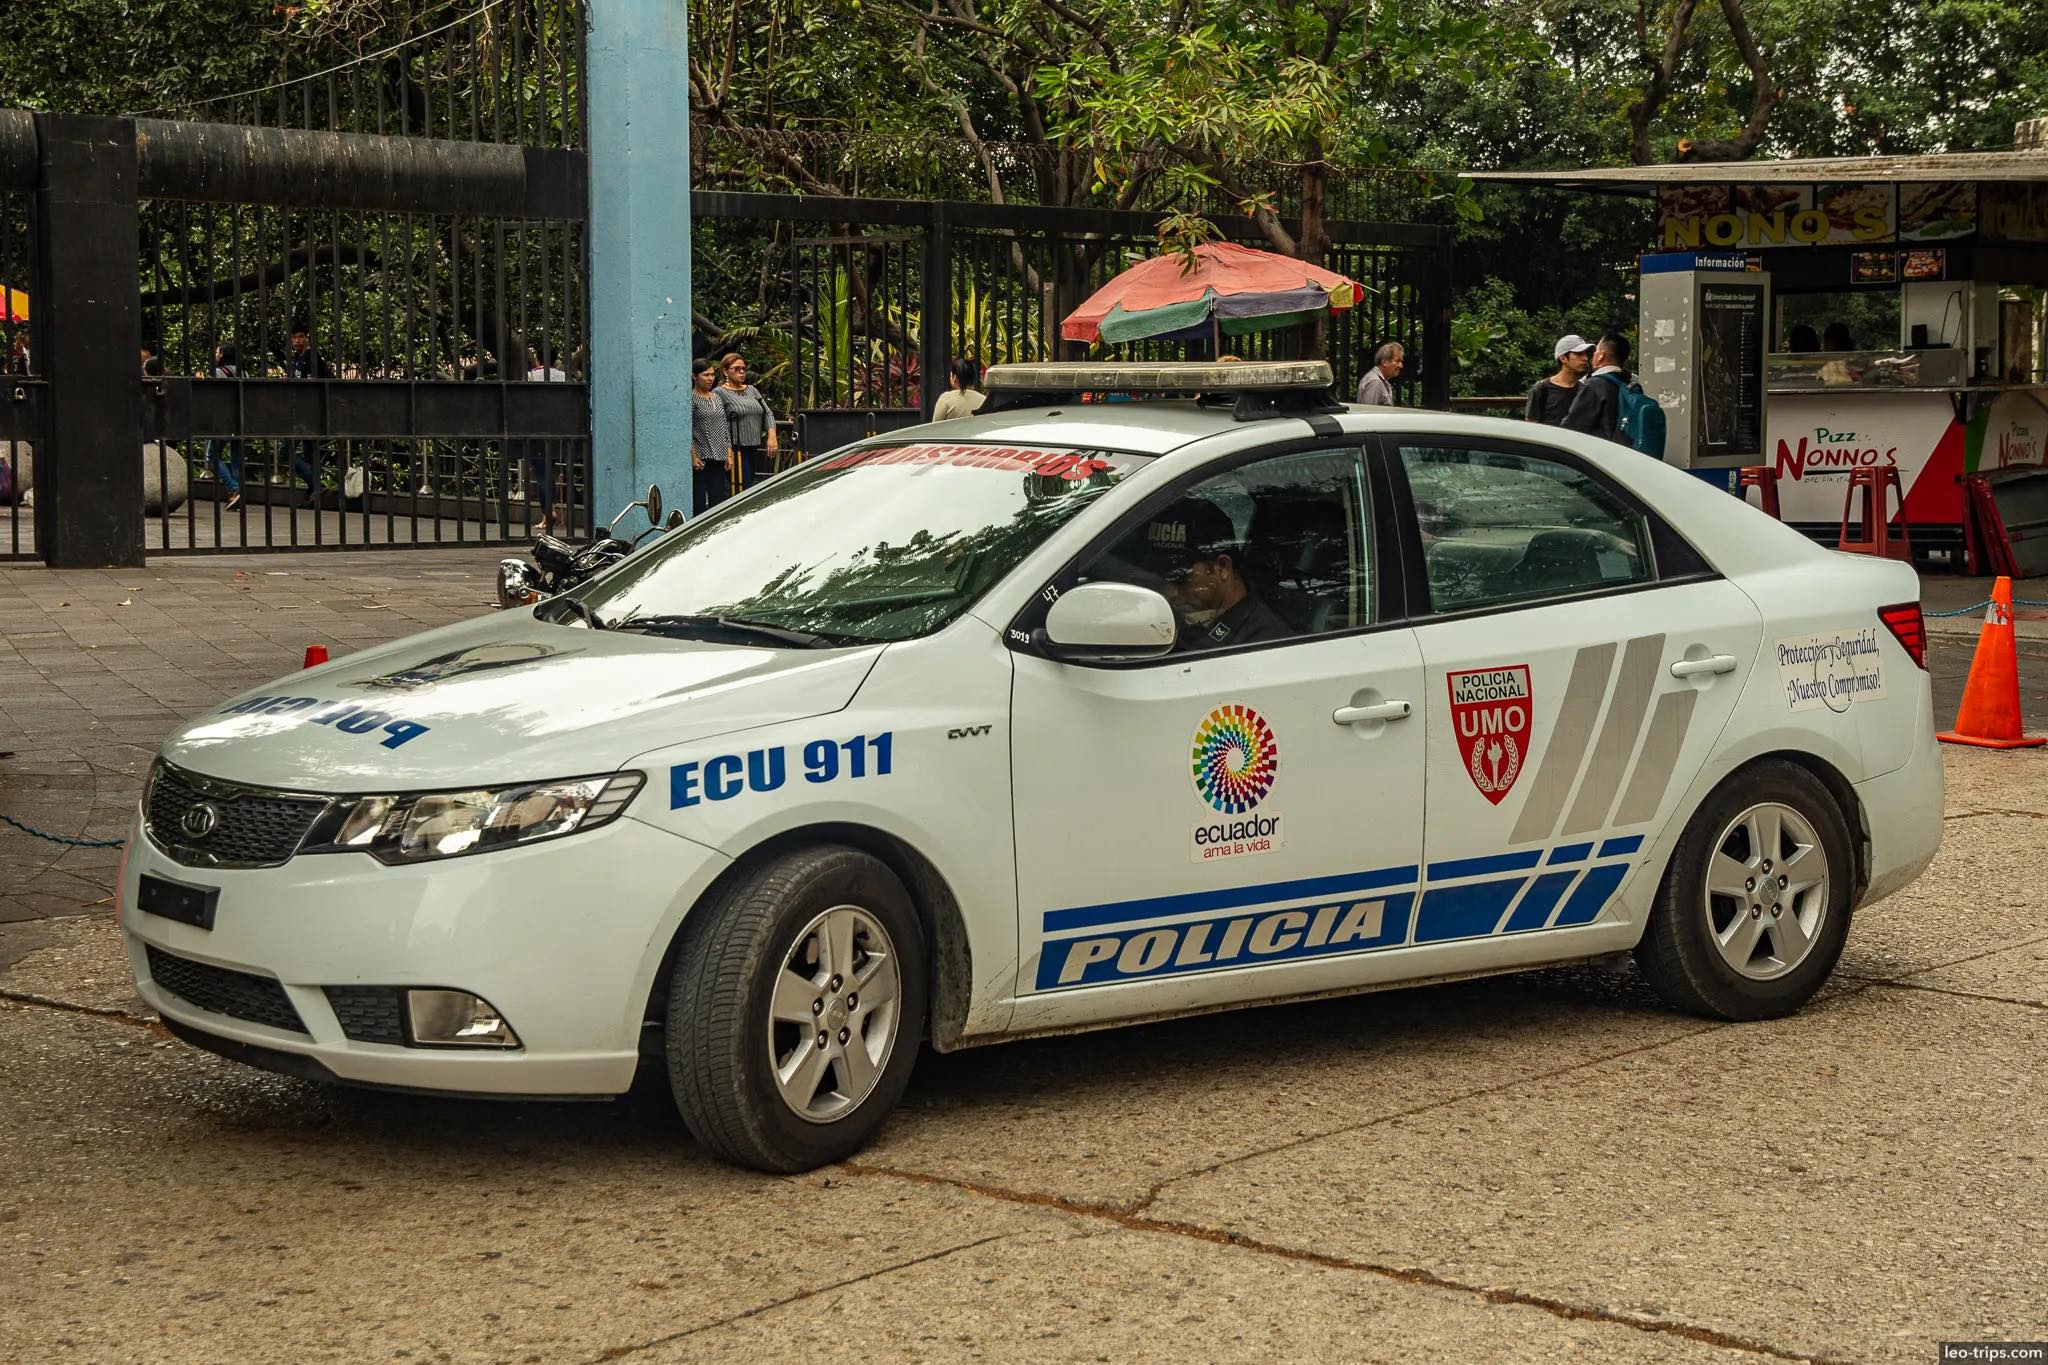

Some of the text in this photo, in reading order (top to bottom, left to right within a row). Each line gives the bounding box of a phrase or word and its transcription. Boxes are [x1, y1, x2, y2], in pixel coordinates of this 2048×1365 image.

[1695, 256, 1744, 269] Información
[1042, 584, 1060, 603] 47
[1777, 627, 1881, 668] Protección y Seguridad,
[1462, 671, 1516, 689] POLICIA
[1787, 667, 1882, 709] ¡Nuestro Compromiso!
[1456, 684, 1526, 703] NACIONAL
[947, 724, 993, 741] CVVT
[1460, 705, 1526, 737] UMO
[670, 731, 893, 811] ECU 911
[1194, 813, 1280, 845] ecuador
[1203, 838, 1271, 859] ama la vida
[1057, 899, 1386, 985] POLICIA
